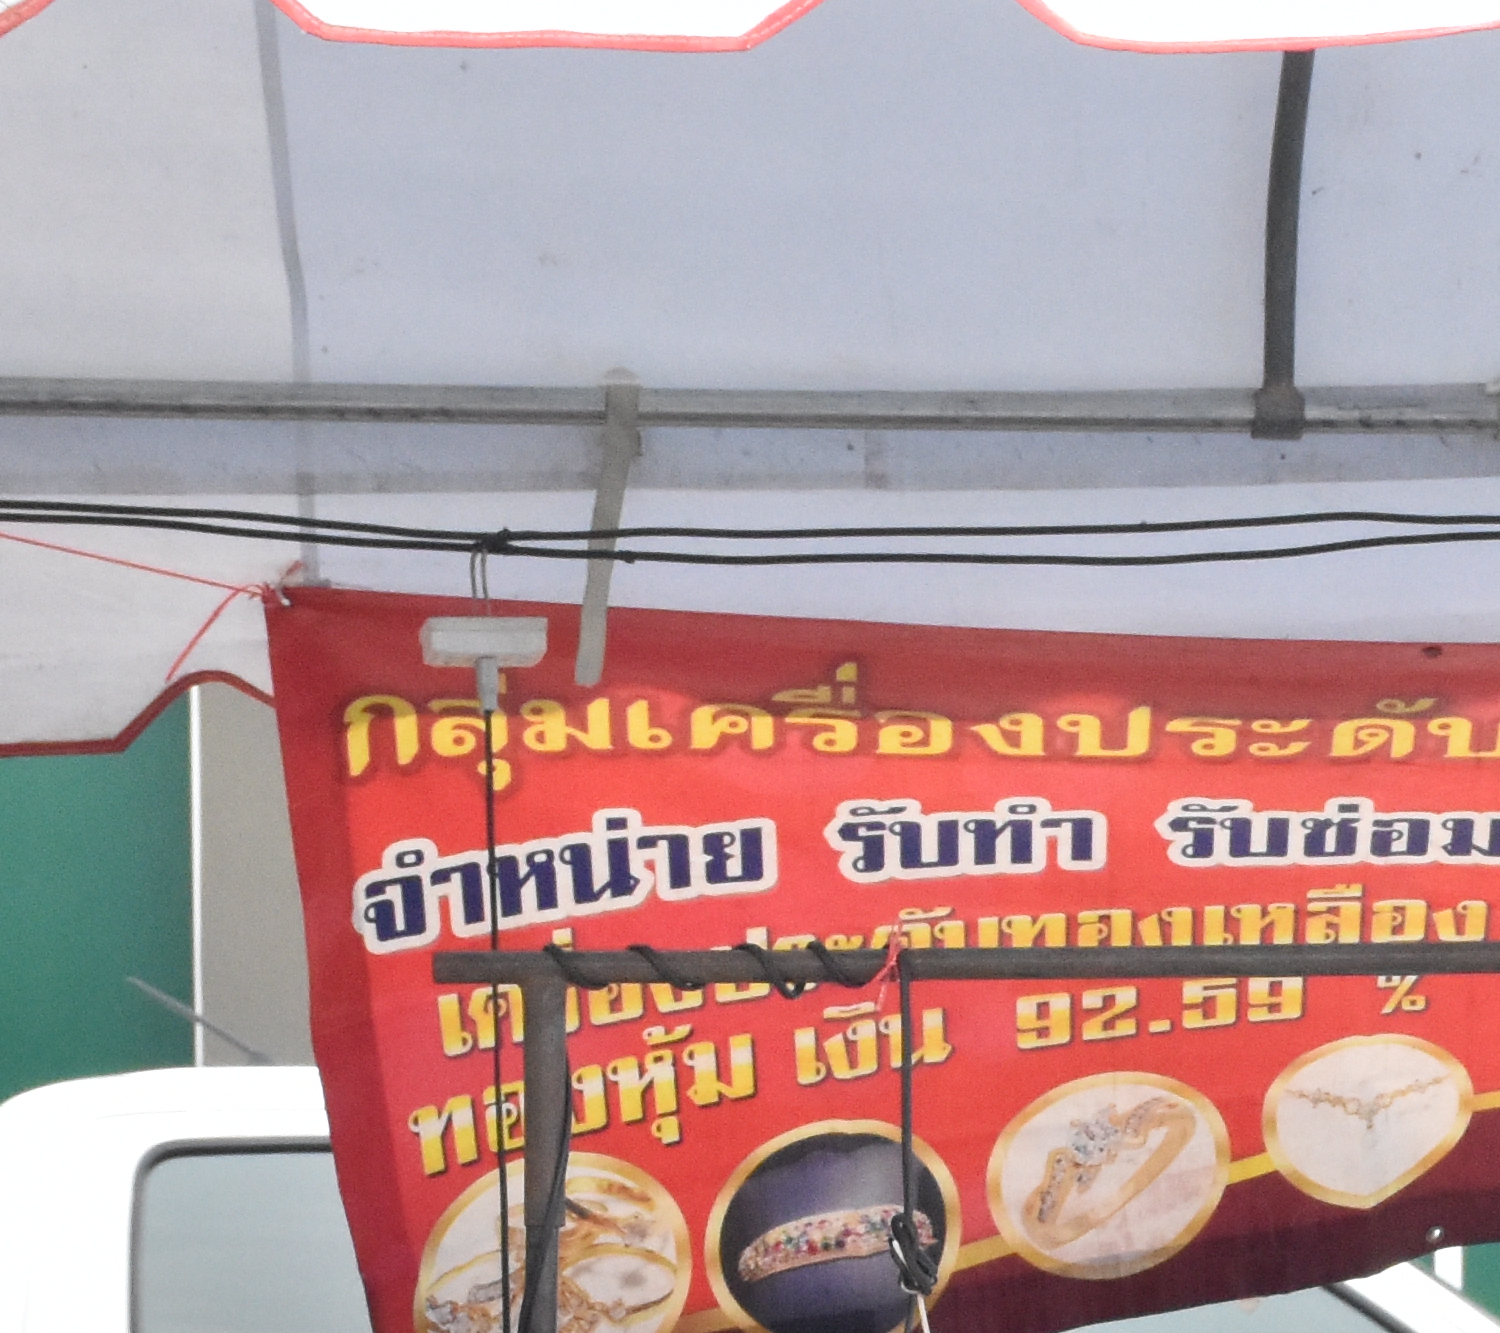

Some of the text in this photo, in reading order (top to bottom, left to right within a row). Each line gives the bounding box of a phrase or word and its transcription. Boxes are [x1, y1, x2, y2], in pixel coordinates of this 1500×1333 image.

[361, 813, 768, 945] จำหน่าย
[836, 802, 1096, 873] รับทำ
